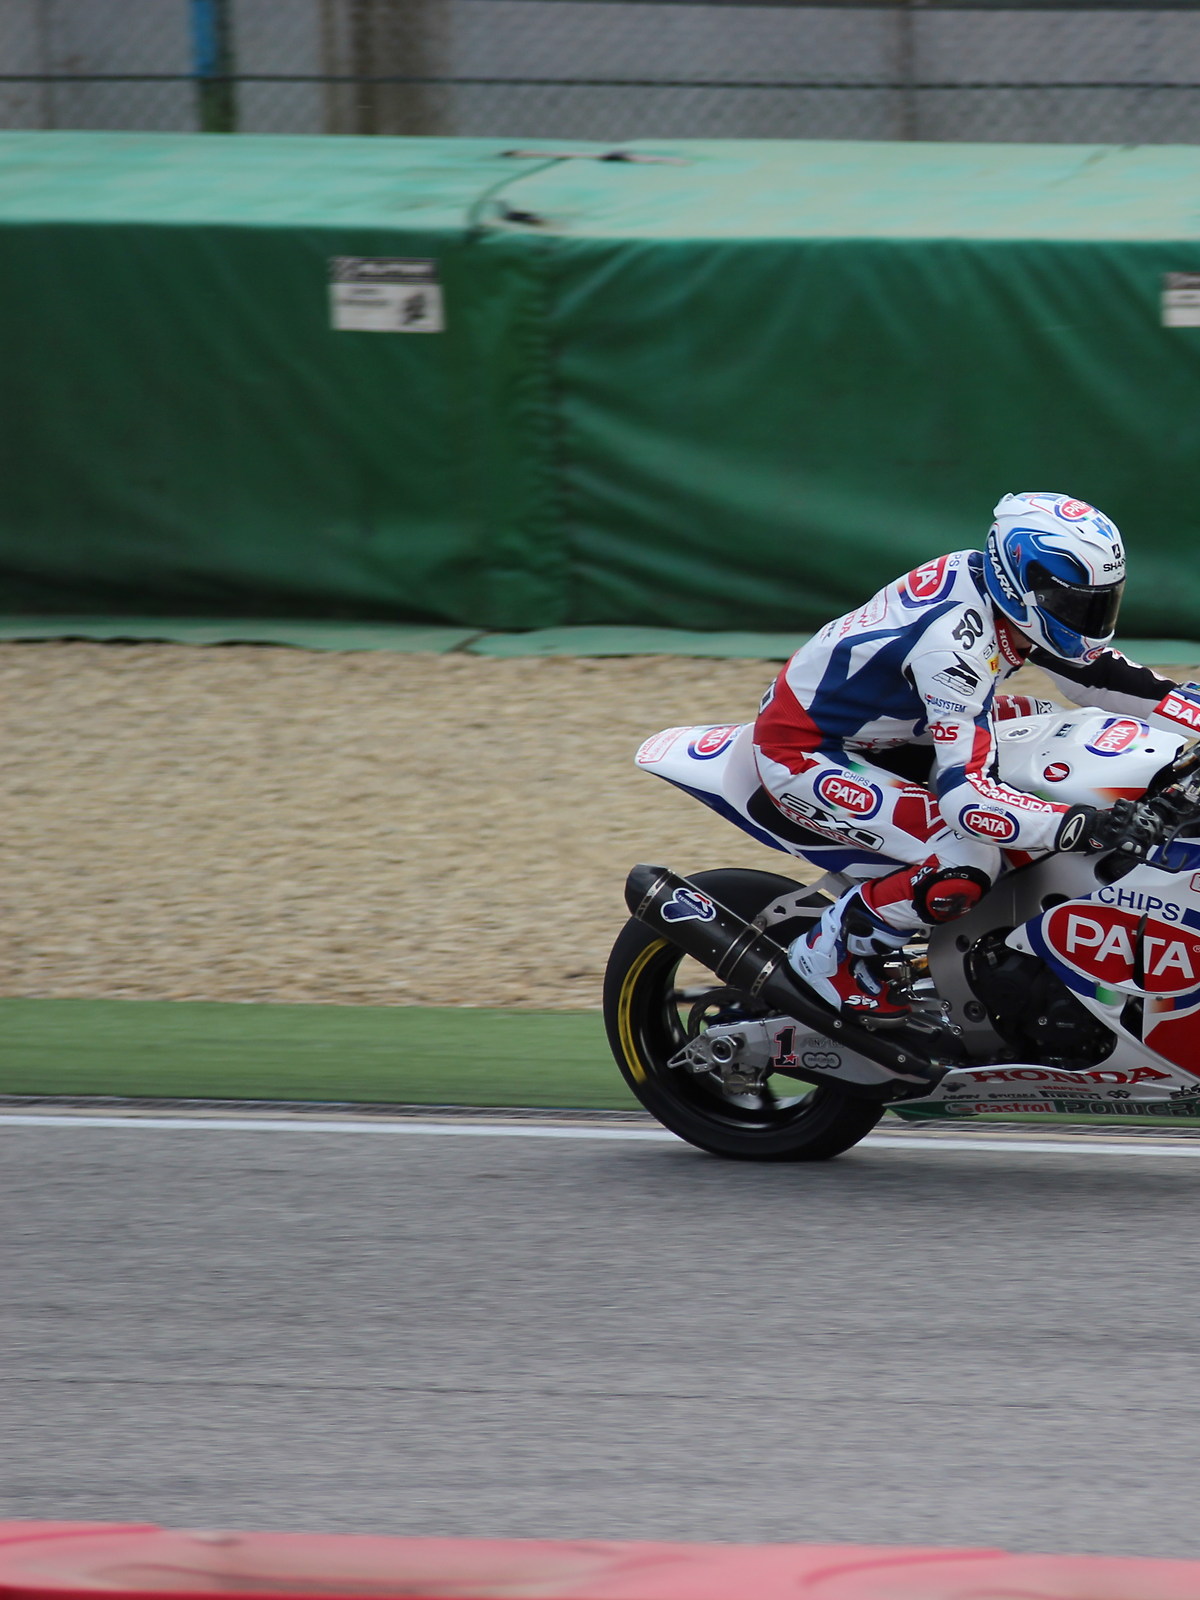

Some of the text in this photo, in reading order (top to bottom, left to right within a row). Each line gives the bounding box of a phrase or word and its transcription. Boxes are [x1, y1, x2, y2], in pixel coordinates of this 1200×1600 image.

[987, 535, 1020, 602] SHARK
[1103, 557, 1125, 572] SHAR
[952, 608, 983, 650] 50
[999, 629, 1021, 666] HONDA
[1099, 726, 1135, 750] PATA
[843, 771, 870, 787] CHIPS
[965, 772, 1054, 814] BARRACUDA
[826, 780, 866, 809] PATA
[970, 813, 1006, 835] PATA
[981, 804, 1004, 815] CHIPS
[1098, 886, 1181, 922] CHIPS
[1065, 913, 1195, 979] PATA
[773, 1025, 798, 1068] 1
[965, 1066, 1173, 1086] HONDA
[974, 1102, 1055, 1114] Castrol
